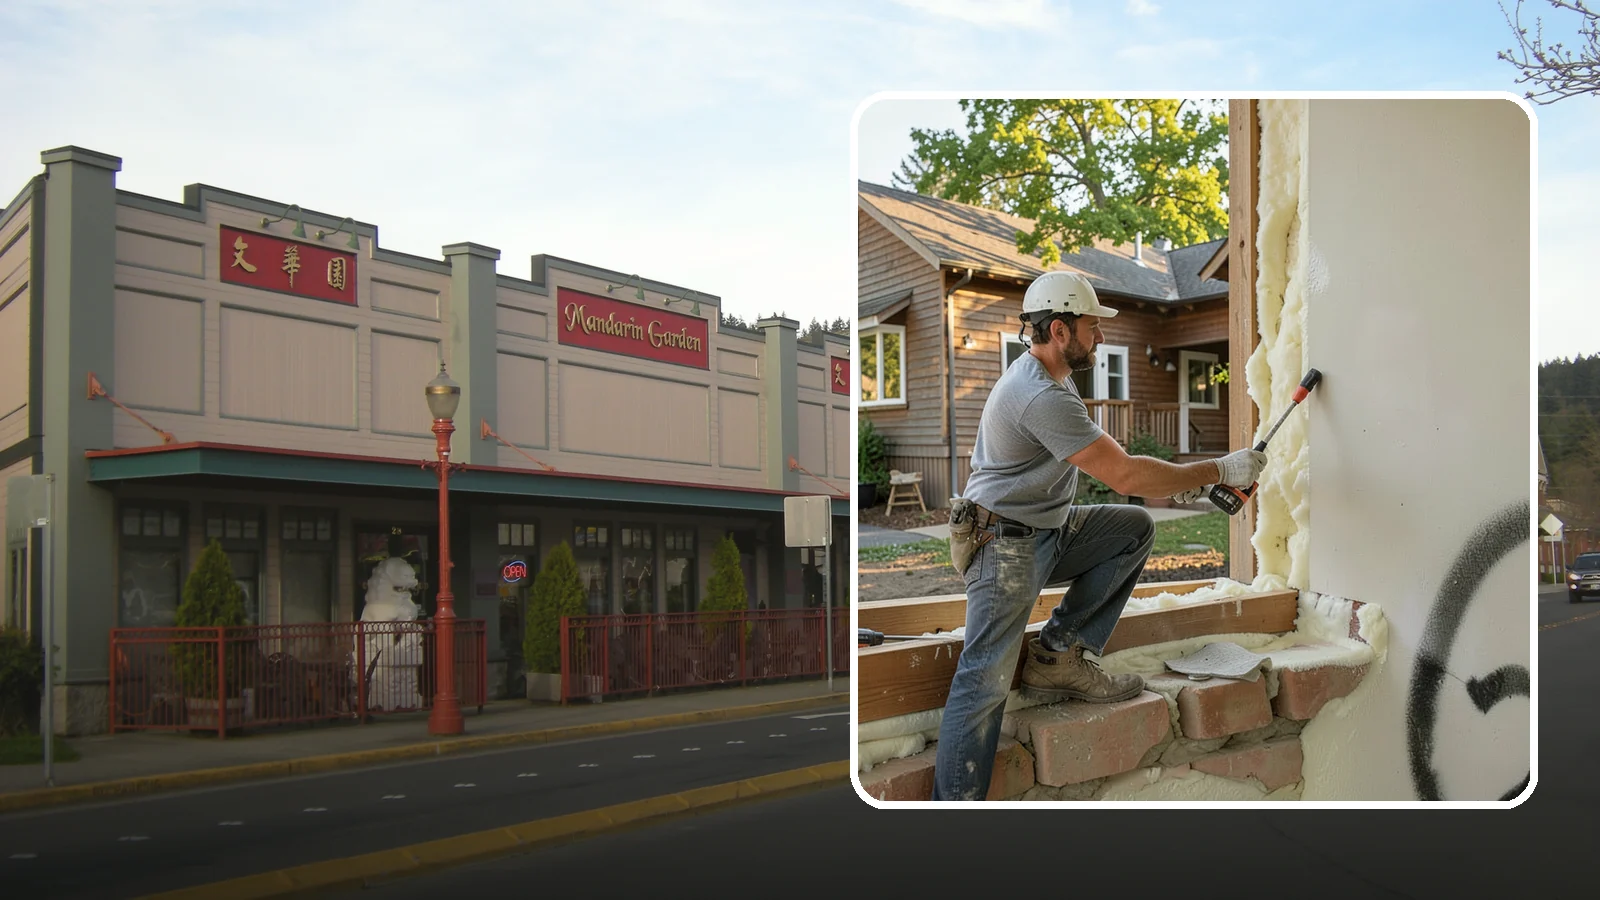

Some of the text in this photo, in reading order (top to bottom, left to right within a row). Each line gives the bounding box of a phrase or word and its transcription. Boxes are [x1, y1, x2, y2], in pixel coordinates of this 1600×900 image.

[231, 235, 346, 291] 文華園
[564, 302, 701, 352] Mandarin Garden
[503, 565, 527, 578] OPEN
